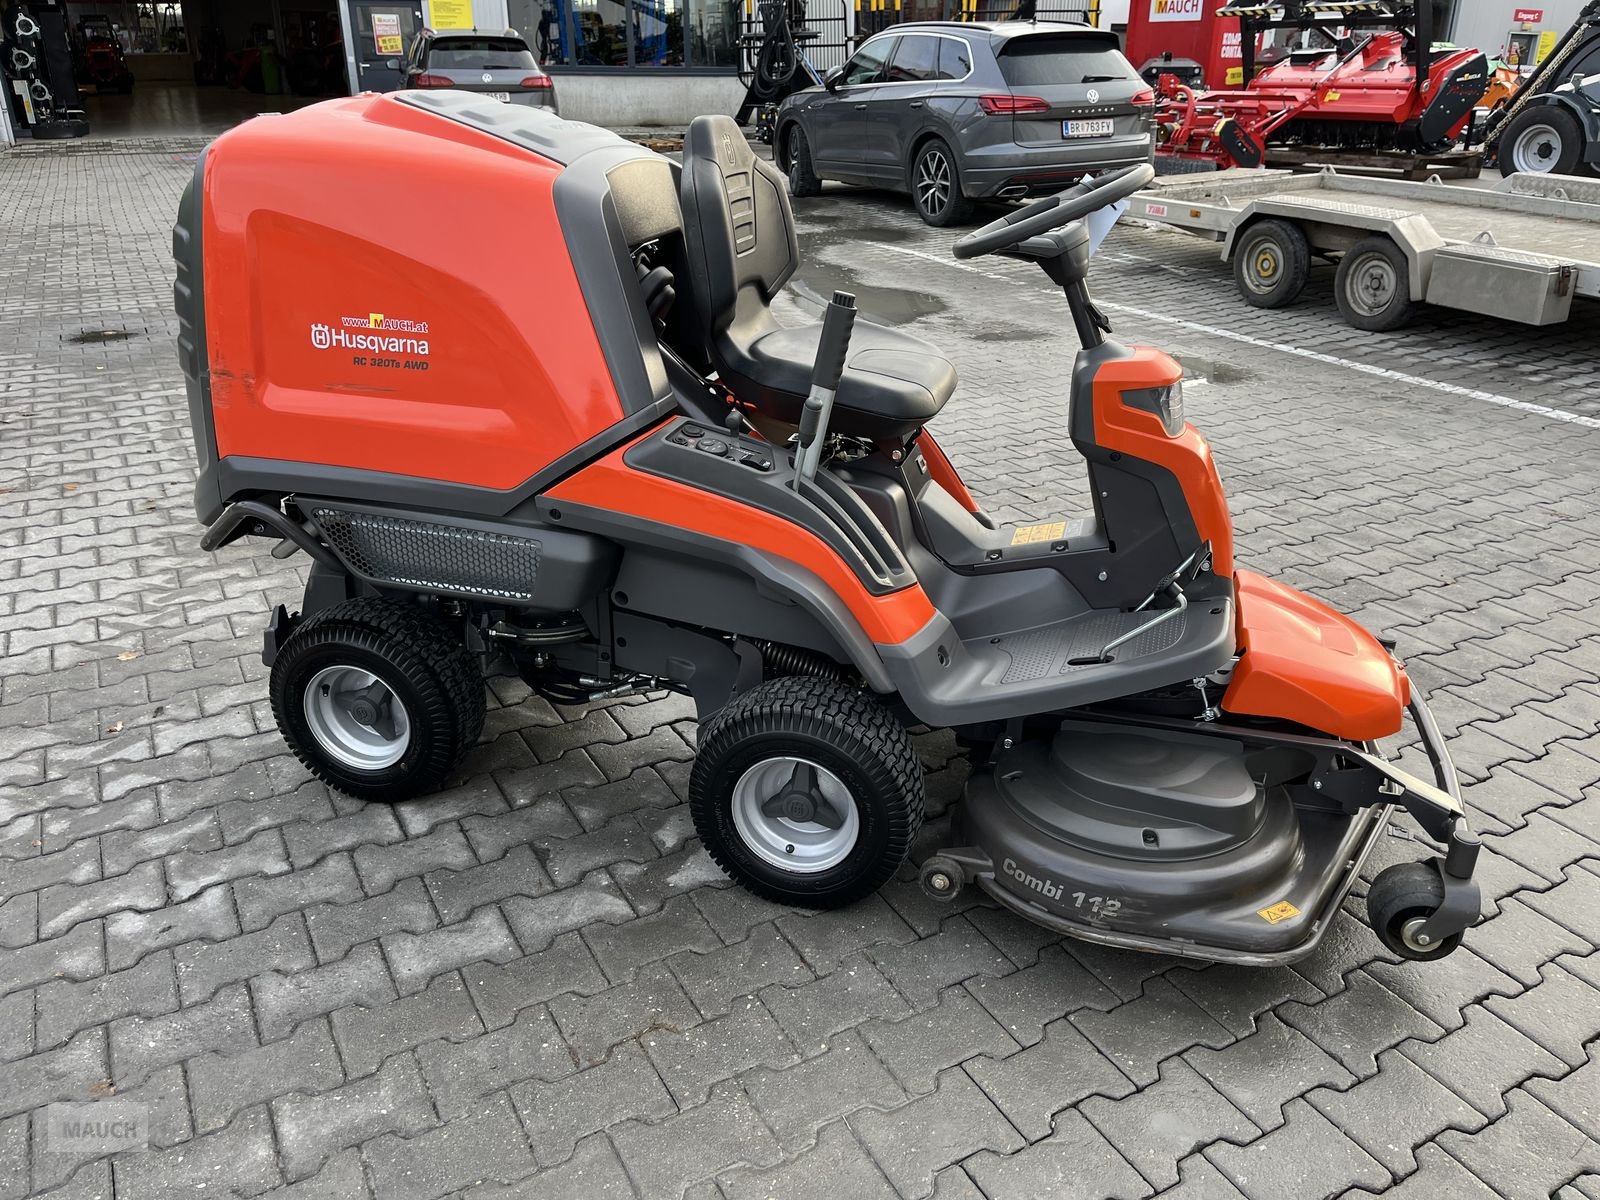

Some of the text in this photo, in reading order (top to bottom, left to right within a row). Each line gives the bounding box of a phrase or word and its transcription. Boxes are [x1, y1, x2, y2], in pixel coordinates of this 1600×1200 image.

[1157, 0, 1199, 13] MAUCH
[1070, 122, 1080, 133] BR
[342, 316, 428, 333] www.MAUCH.at
[332, 328, 429, 355] Husqvarna
[353, 356, 429, 371] RC 320Ts AWD
[1002, 857, 1122, 917] Combi 112
